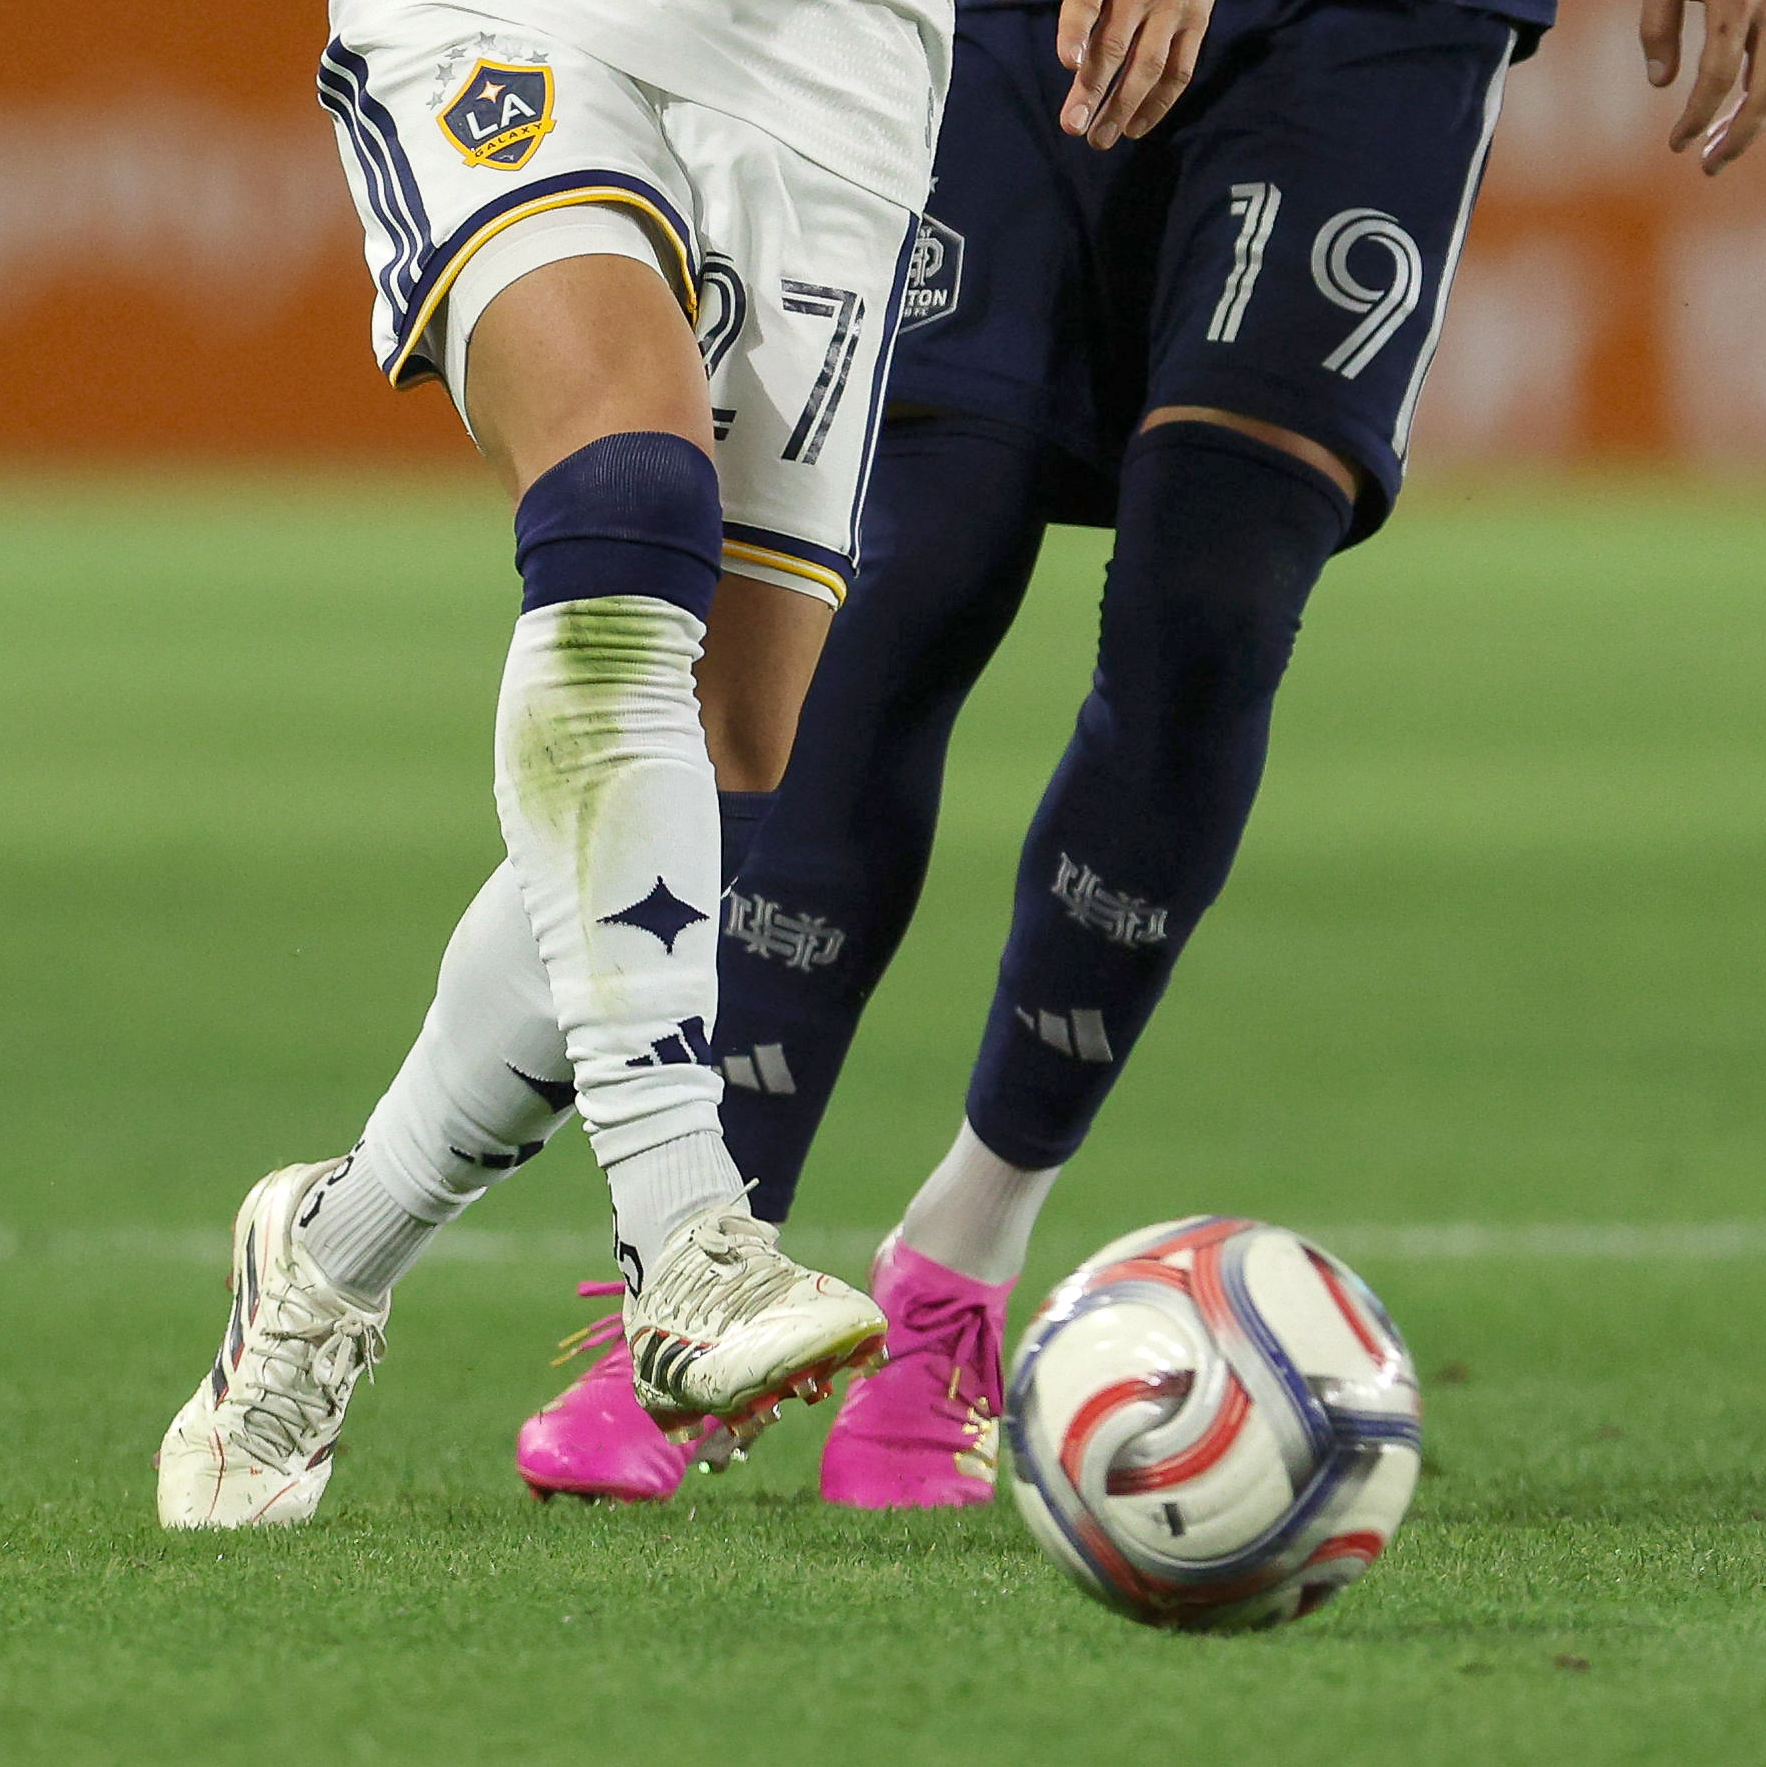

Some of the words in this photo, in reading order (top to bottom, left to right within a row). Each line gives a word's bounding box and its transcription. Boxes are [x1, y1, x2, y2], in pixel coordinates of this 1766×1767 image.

[465, 92, 537, 141] LA
[474, 122, 543, 158] GALAXY
[1206, 181, 1423, 380] 19
